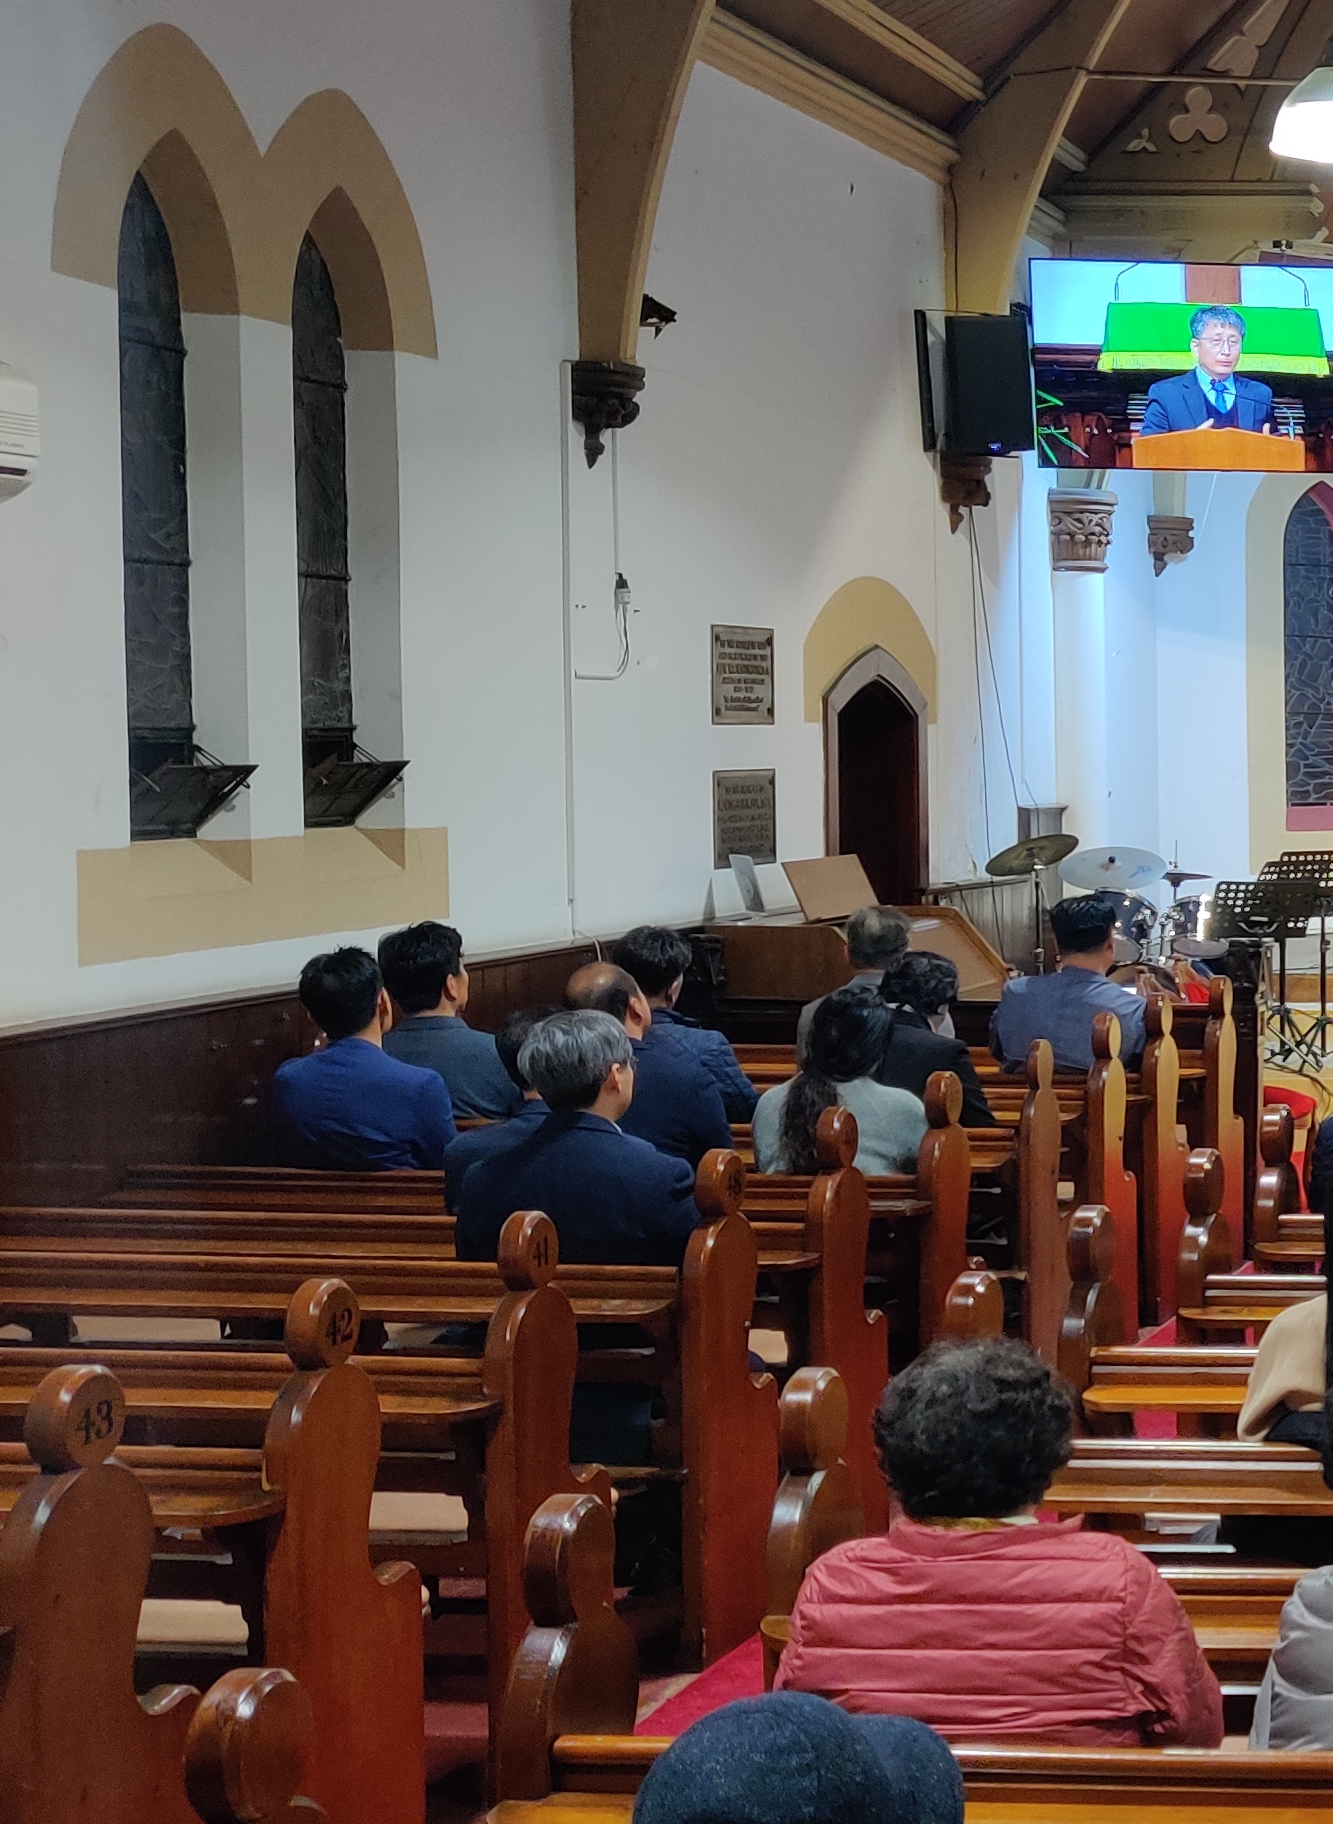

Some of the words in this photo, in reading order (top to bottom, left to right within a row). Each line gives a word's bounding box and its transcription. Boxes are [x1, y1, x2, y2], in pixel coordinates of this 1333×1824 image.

[533, 1235, 549, 1269] 41
[325, 1307, 354, 1347] 42
[75, 1399, 114, 1446] 43
